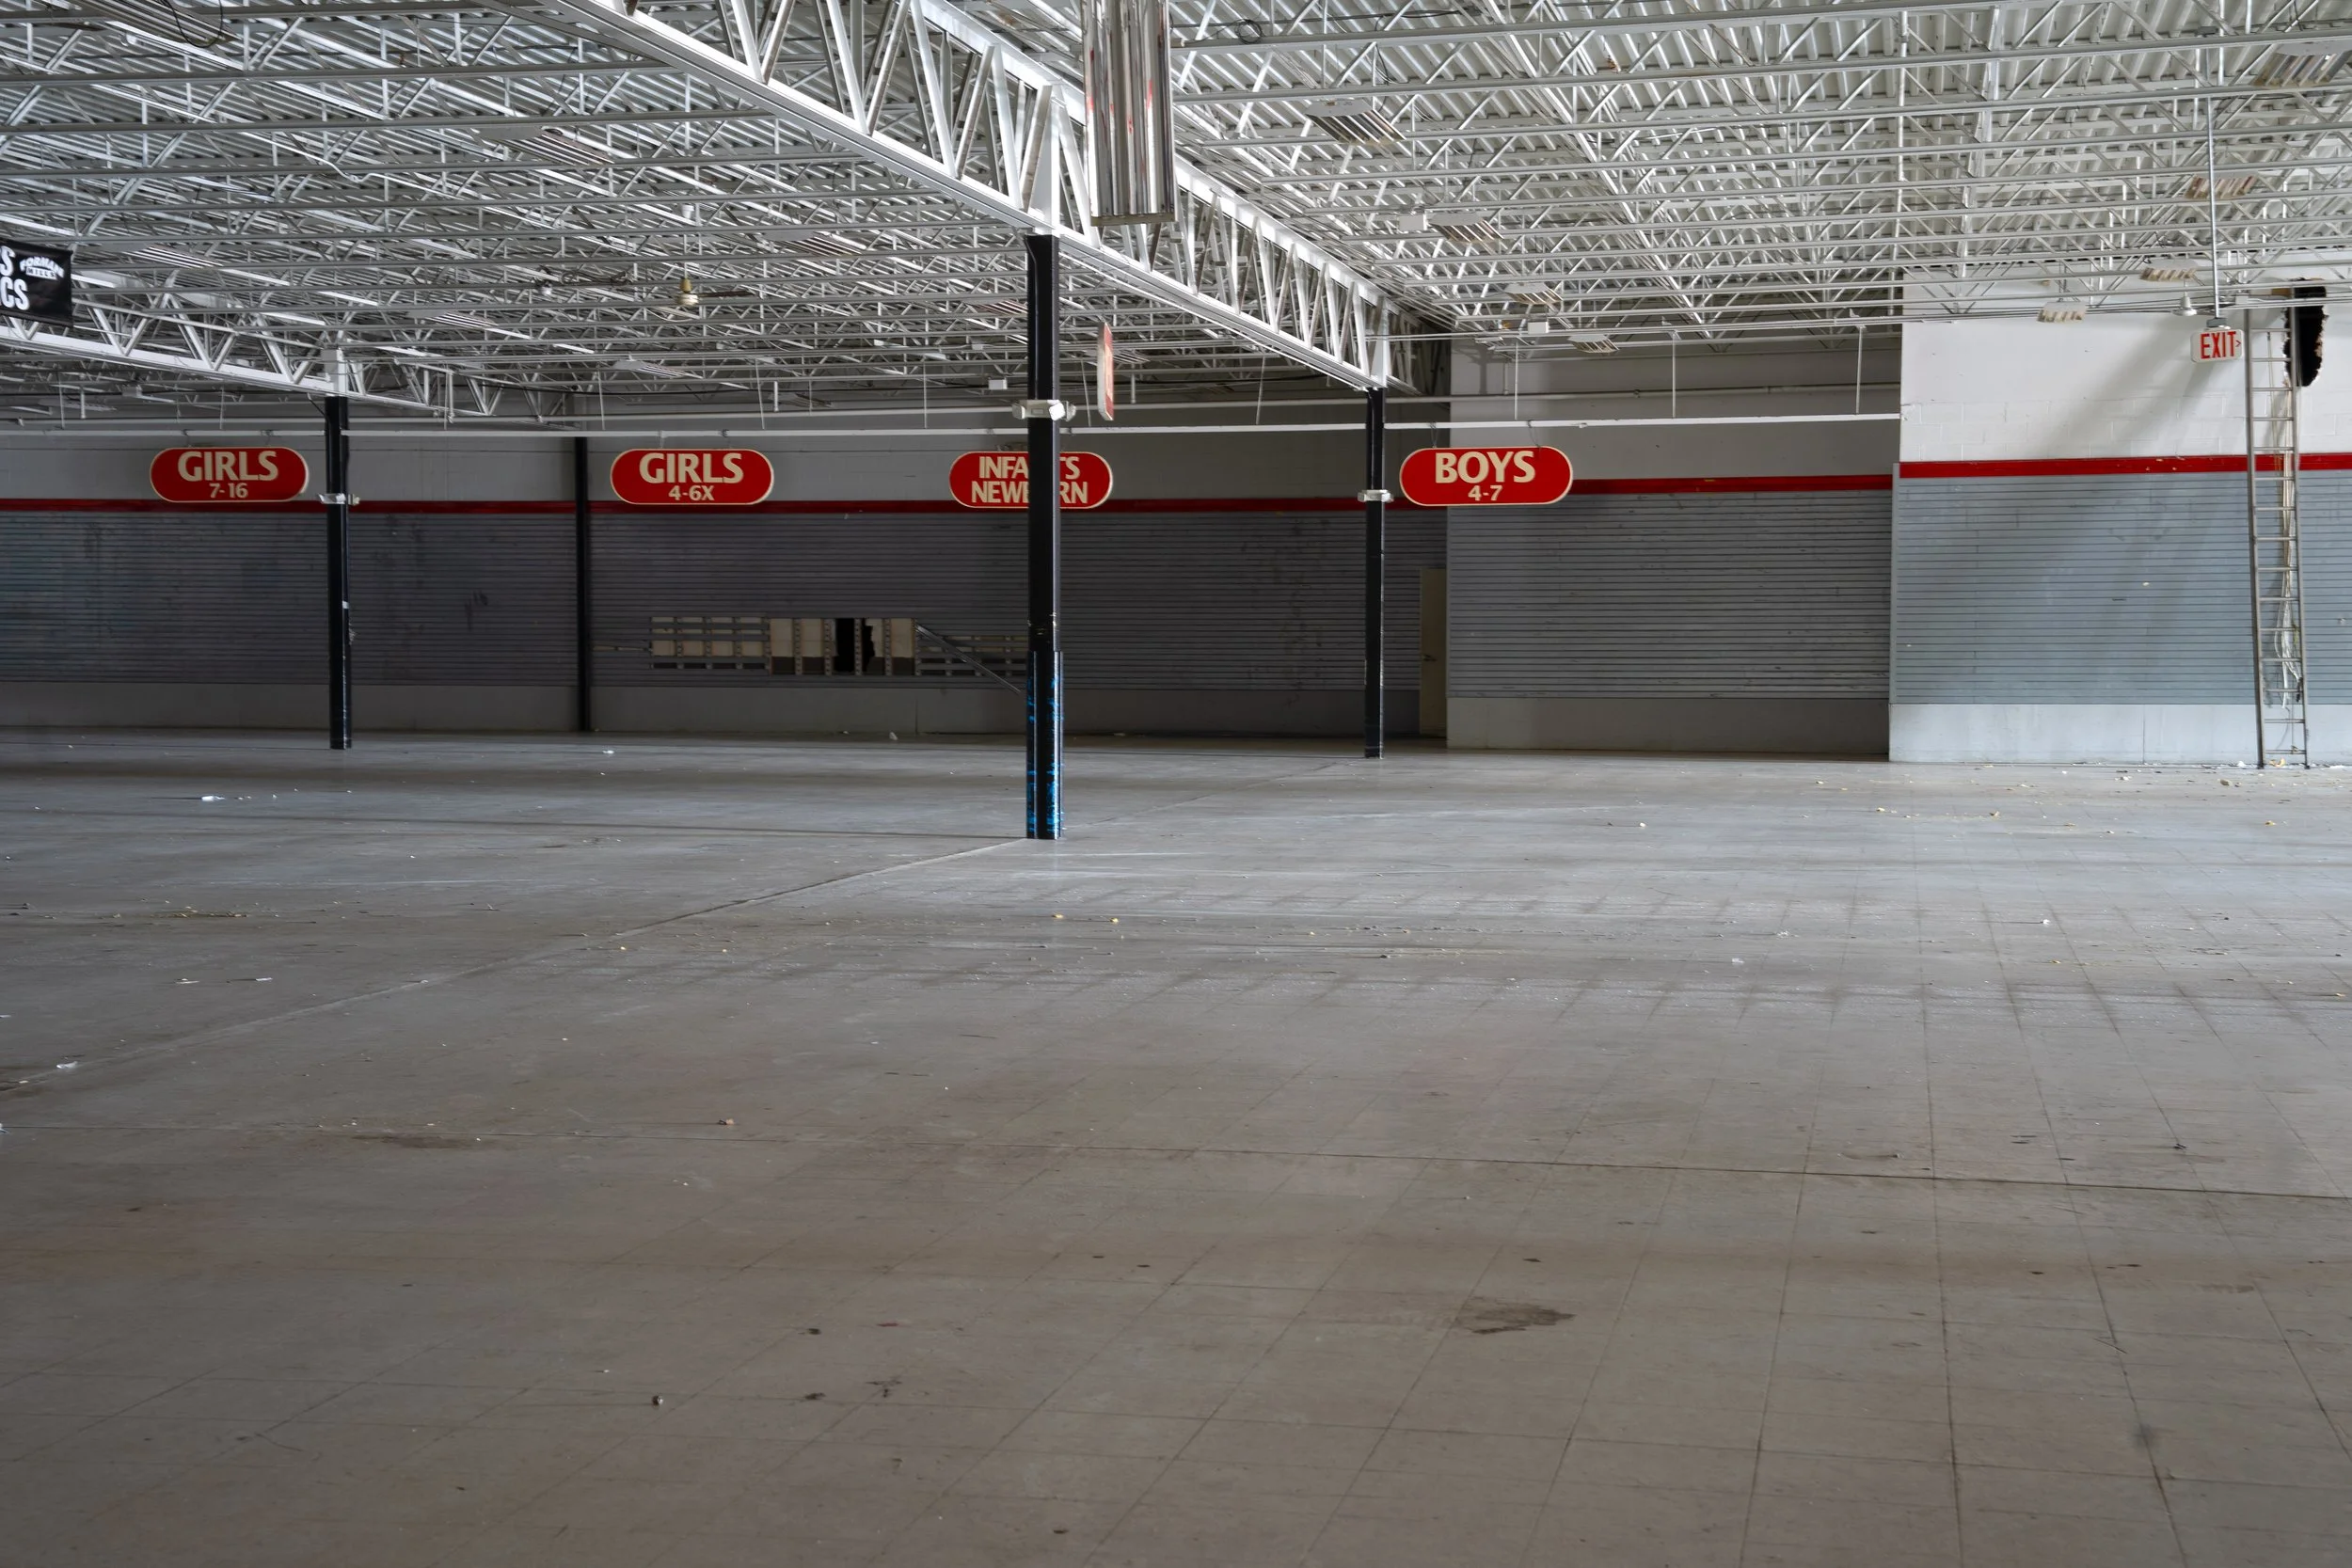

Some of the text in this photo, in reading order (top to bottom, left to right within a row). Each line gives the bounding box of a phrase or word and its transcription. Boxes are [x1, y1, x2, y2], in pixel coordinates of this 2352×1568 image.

[26, 267, 56, 277] MILLS
[2200, 331, 2236, 359] EXIT
[178, 451, 278, 482] GIRLS
[639, 452, 744, 483] GIRLS
[979, 456, 1080, 480] INFAS
[1435, 451, 1536, 483] BOYS
[209, 483, 248, 499] 7-16
[668, 484, 715, 501] 4-6X
[971, 481, 1089, 503] NEWRN
[1468, 484, 1502, 501] 4-7
